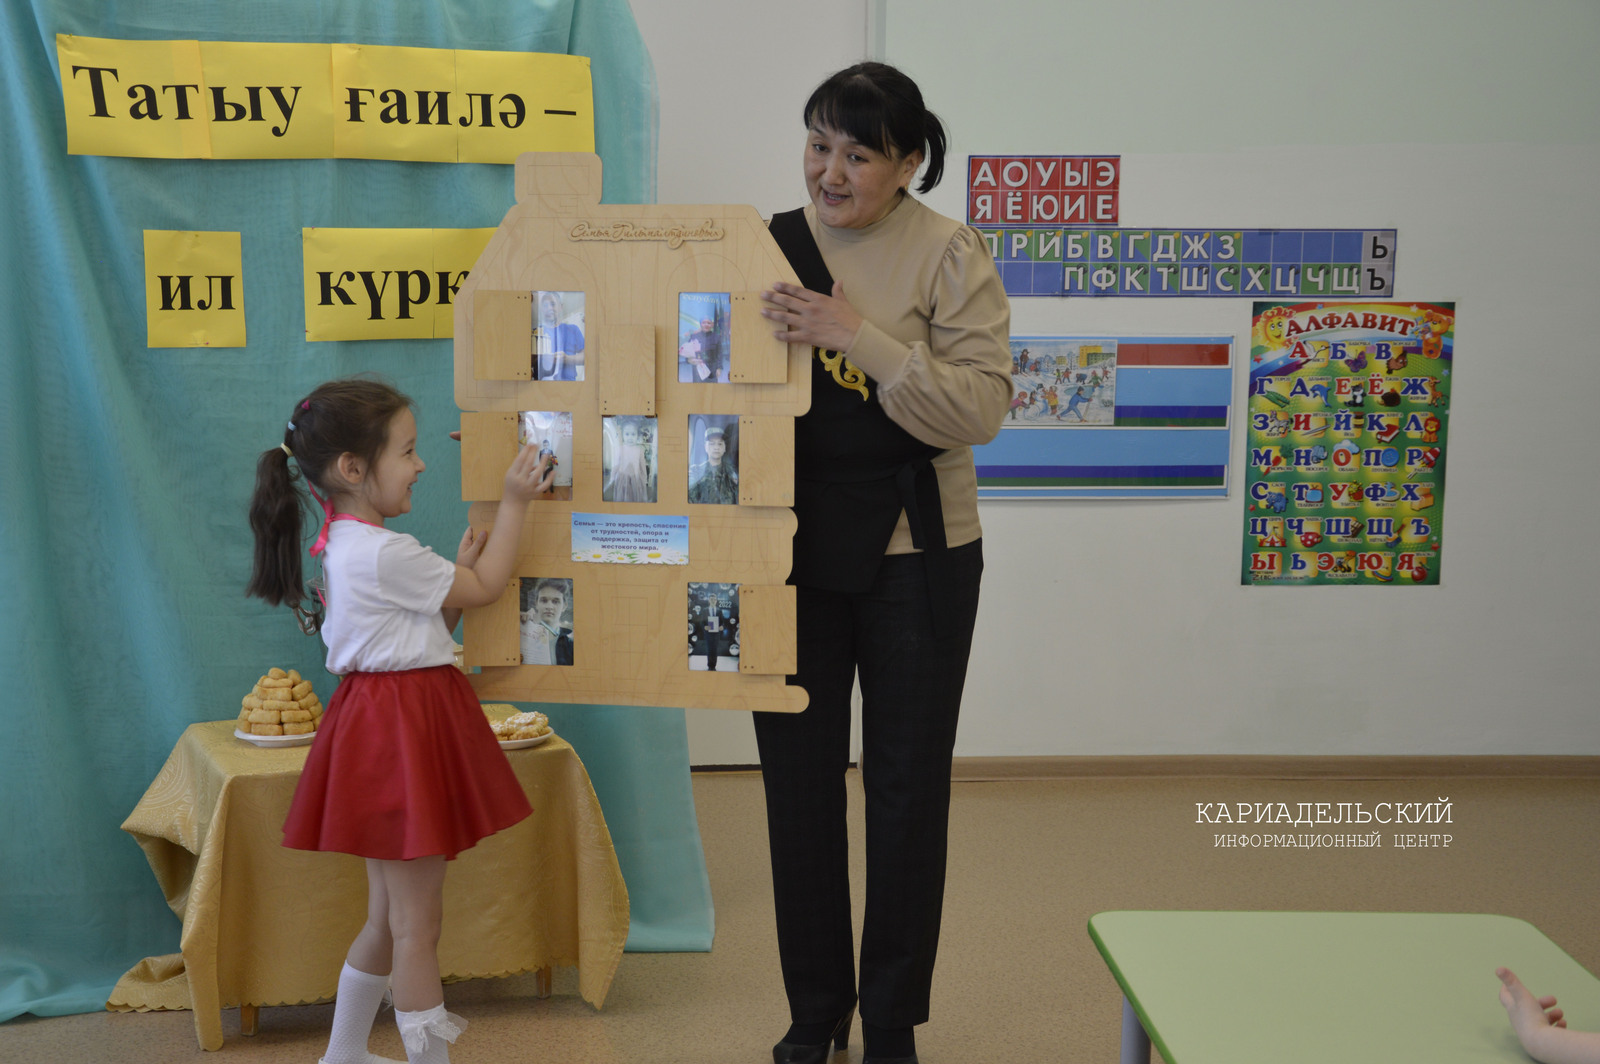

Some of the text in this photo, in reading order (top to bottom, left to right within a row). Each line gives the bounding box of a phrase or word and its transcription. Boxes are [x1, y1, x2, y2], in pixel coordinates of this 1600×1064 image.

[72, 65, 302, 138] Татыу
[345, 86, 527, 129] ғаилә
[157, 273, 236, 311] ил
[1286, 312, 1416, 338] АЛФАВИТ
[1289, 341, 1392, 359] А Б В
[1256, 373, 1430, 397] Г Д Е Ё Ж
[1253, 409, 1424, 431] З И Й К Л
[1252, 448, 1423, 466] М Н О П Р
[1251, 481, 1420, 501] С Т У Ф Х
[1249, 519, 1430, 537] Ц Ч Ш Щ Ъ
[1251, 553, 1415, 570] Ы Ь Э Ю Я
